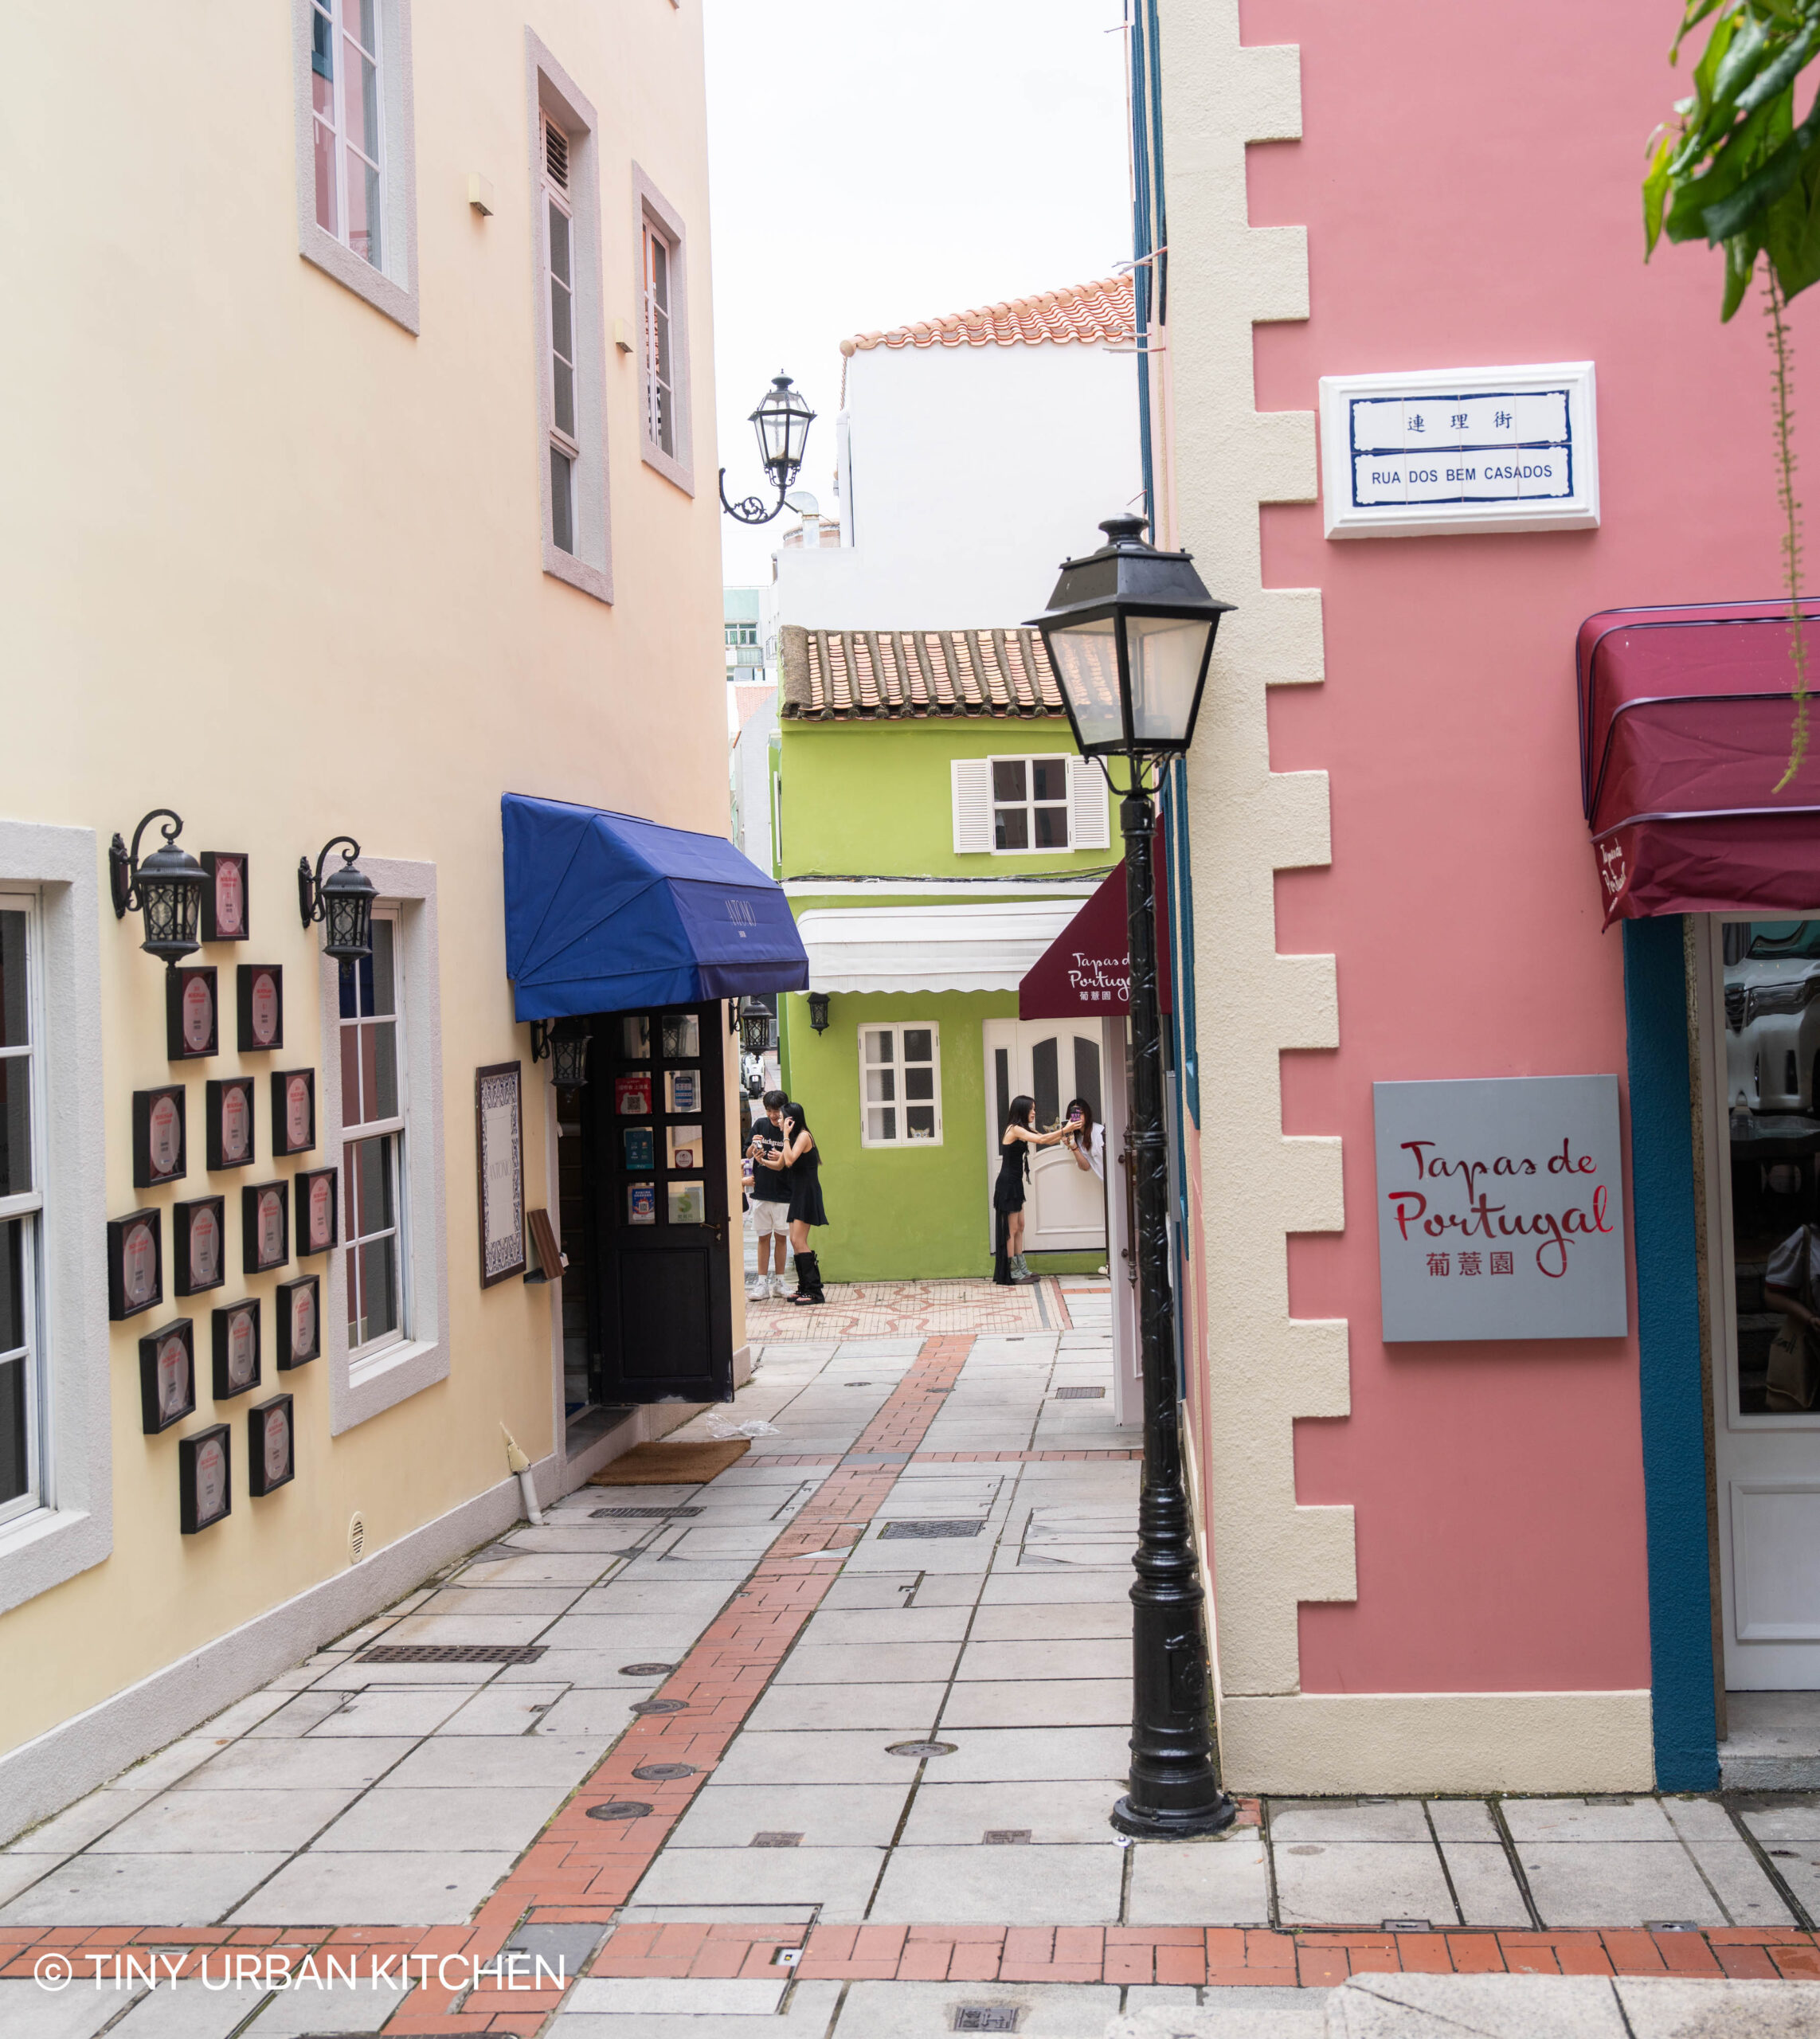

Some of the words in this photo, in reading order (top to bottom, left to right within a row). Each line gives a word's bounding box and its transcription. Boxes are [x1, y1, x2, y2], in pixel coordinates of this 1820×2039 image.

[1407, 411, 1513, 432] 連理街
[1372, 472, 1400, 484] RUA
[1409, 470, 1438, 483] DOS
[1446, 468, 1476, 481] BEM
[1485, 464, 1552, 479] CASADOS
[1072, 953, 1118, 976] Tapas
[1121, 952, 1130, 965] d
[1068, 969, 1130, 1001] Portug
[1400, 1141, 1536, 1204] Tapas
[1548, 1137, 1597, 1174] de
[1388, 1185, 1614, 1278] Portugal
[1426, 1251, 1513, 1276] 葡薏園
